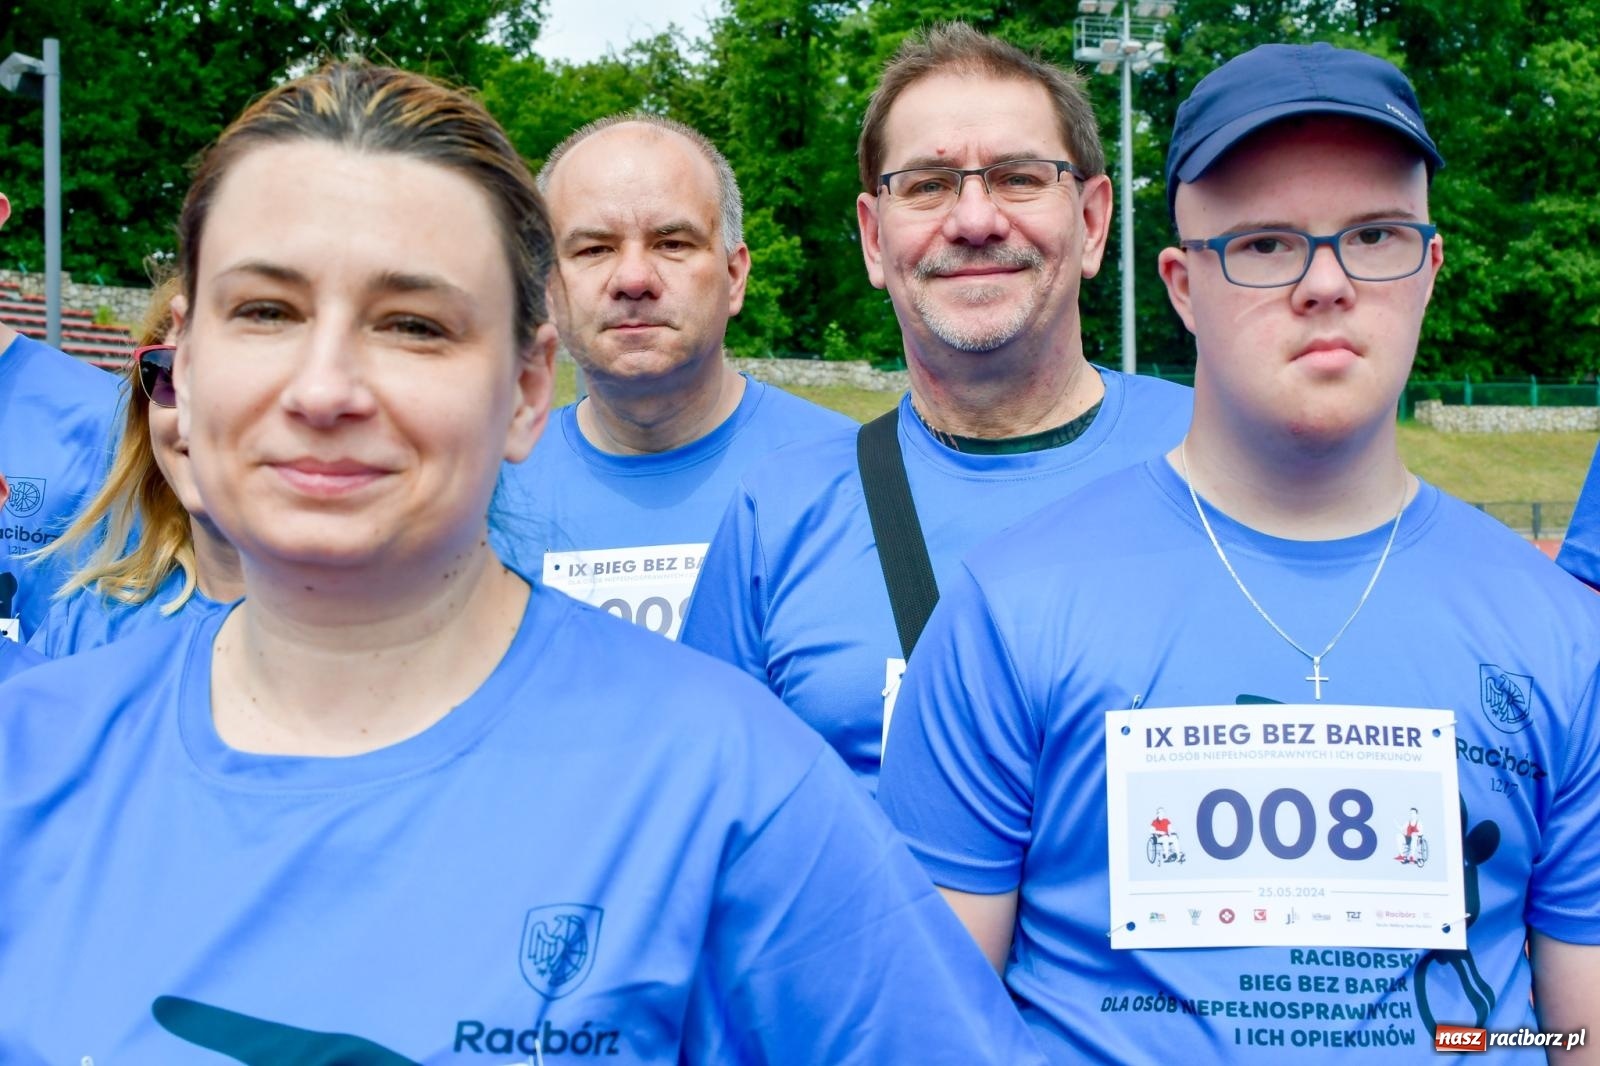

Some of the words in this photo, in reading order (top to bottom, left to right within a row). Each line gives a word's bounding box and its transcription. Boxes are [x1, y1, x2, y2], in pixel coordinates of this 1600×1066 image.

[0, 525, 59, 544] cibór
[569, 564, 588, 577] IX
[593, 560, 637, 575] BIEG
[643, 557, 678, 572] BEZ
[1146, 727, 1174, 748] IX
[1184, 724, 1251, 746] BIEG
[1262, 723, 1316, 745] BEZ
[1326, 724, 1423, 748] BARIER
[1146, 753, 1167, 763] DLA
[1336, 750, 1354, 760] ICH
[1196, 788, 1378, 861] 008
[1258, 886, 1326, 898] 25.05.2024
[1239, 974, 1292, 992] BIEG
[1298, 975, 1340, 993] BEZ
[1100, 996, 1129, 1013] DLA
[1132, 990, 1178, 1014] OSÓB
[1235, 1028, 1242, 1045] I
[1247, 1028, 1285, 1047] ICH
[1290, 1023, 1416, 1048] OPIEKUNÓW
